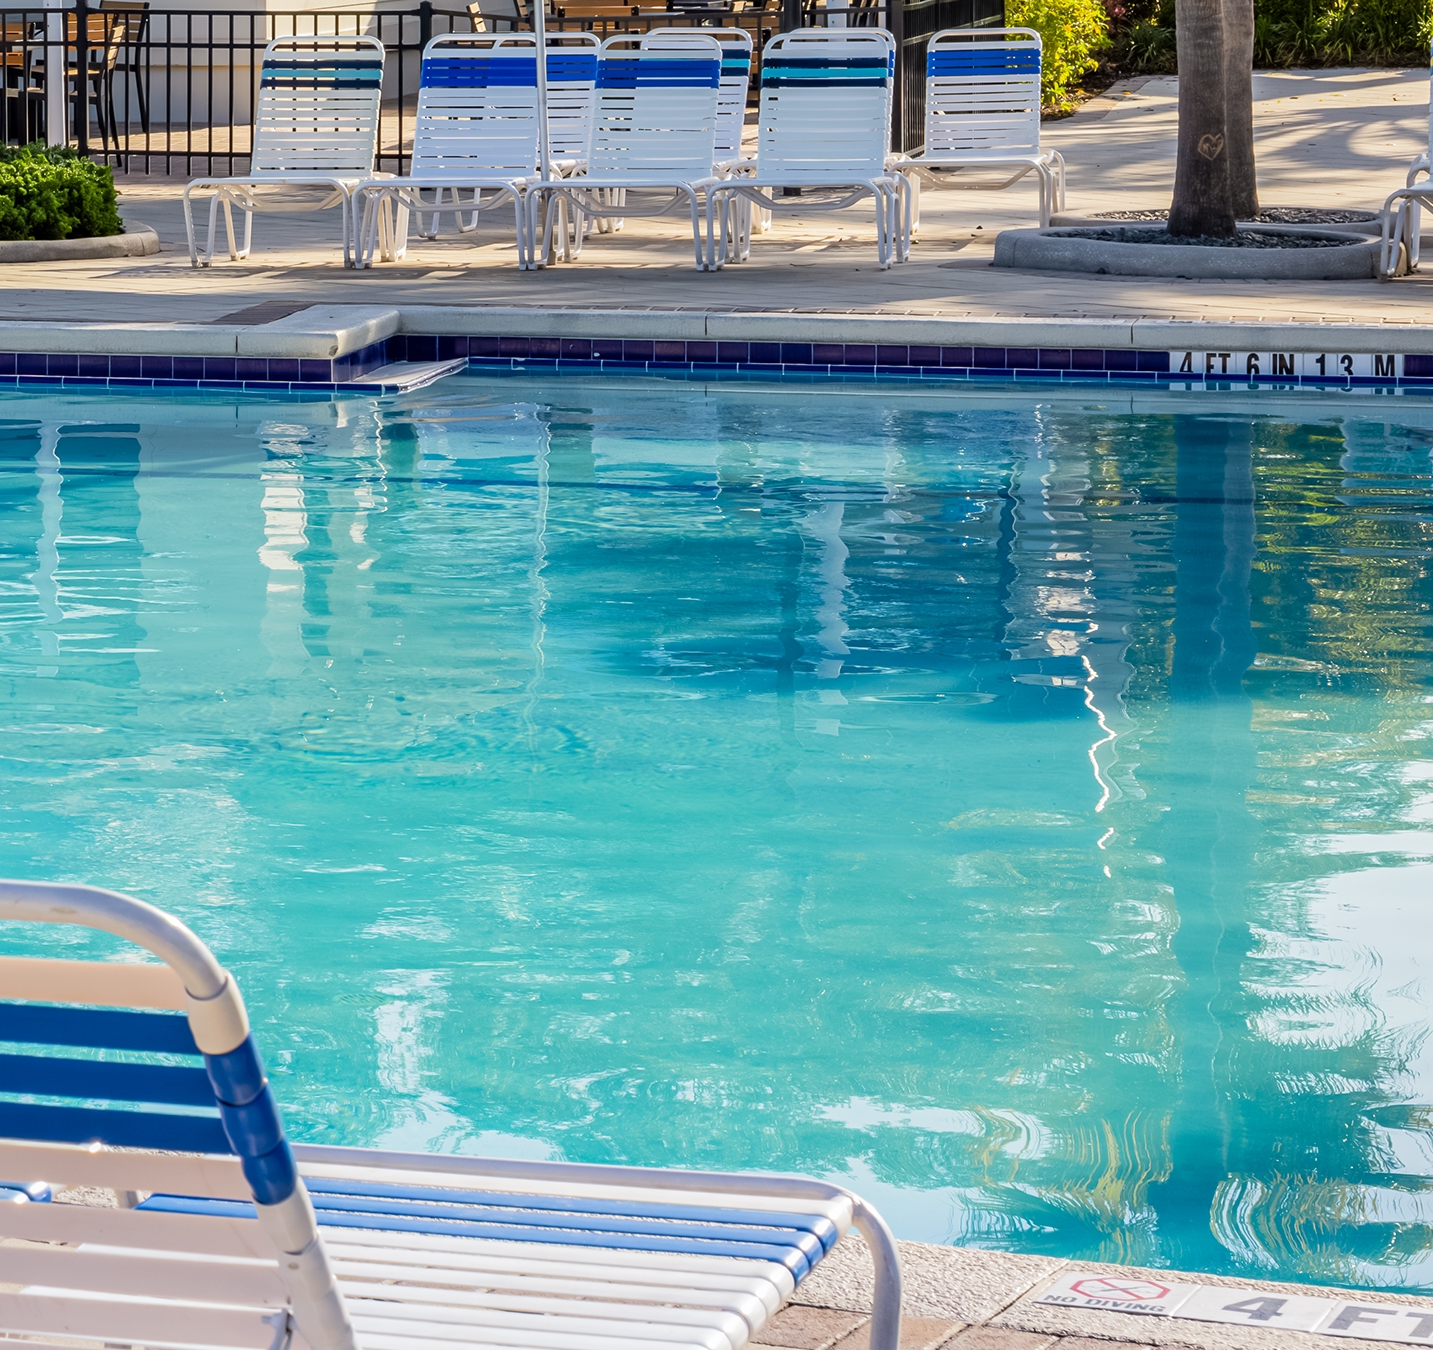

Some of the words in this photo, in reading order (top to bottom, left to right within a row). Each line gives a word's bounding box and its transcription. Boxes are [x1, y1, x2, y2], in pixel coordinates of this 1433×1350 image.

[1179, 352, 1194, 373] 4
[1206, 353, 1231, 374] FT
[1246, 353, 1260, 375] 6
[1272, 353, 1295, 376] IN
[1375, 354, 1395, 377] M
[1043, 1294, 1077, 1303] NO
[1084, 1298, 1166, 1312] DIVING
[1222, 1296, 1289, 1321] 4
[1328, 1305, 1433, 1338] FT
